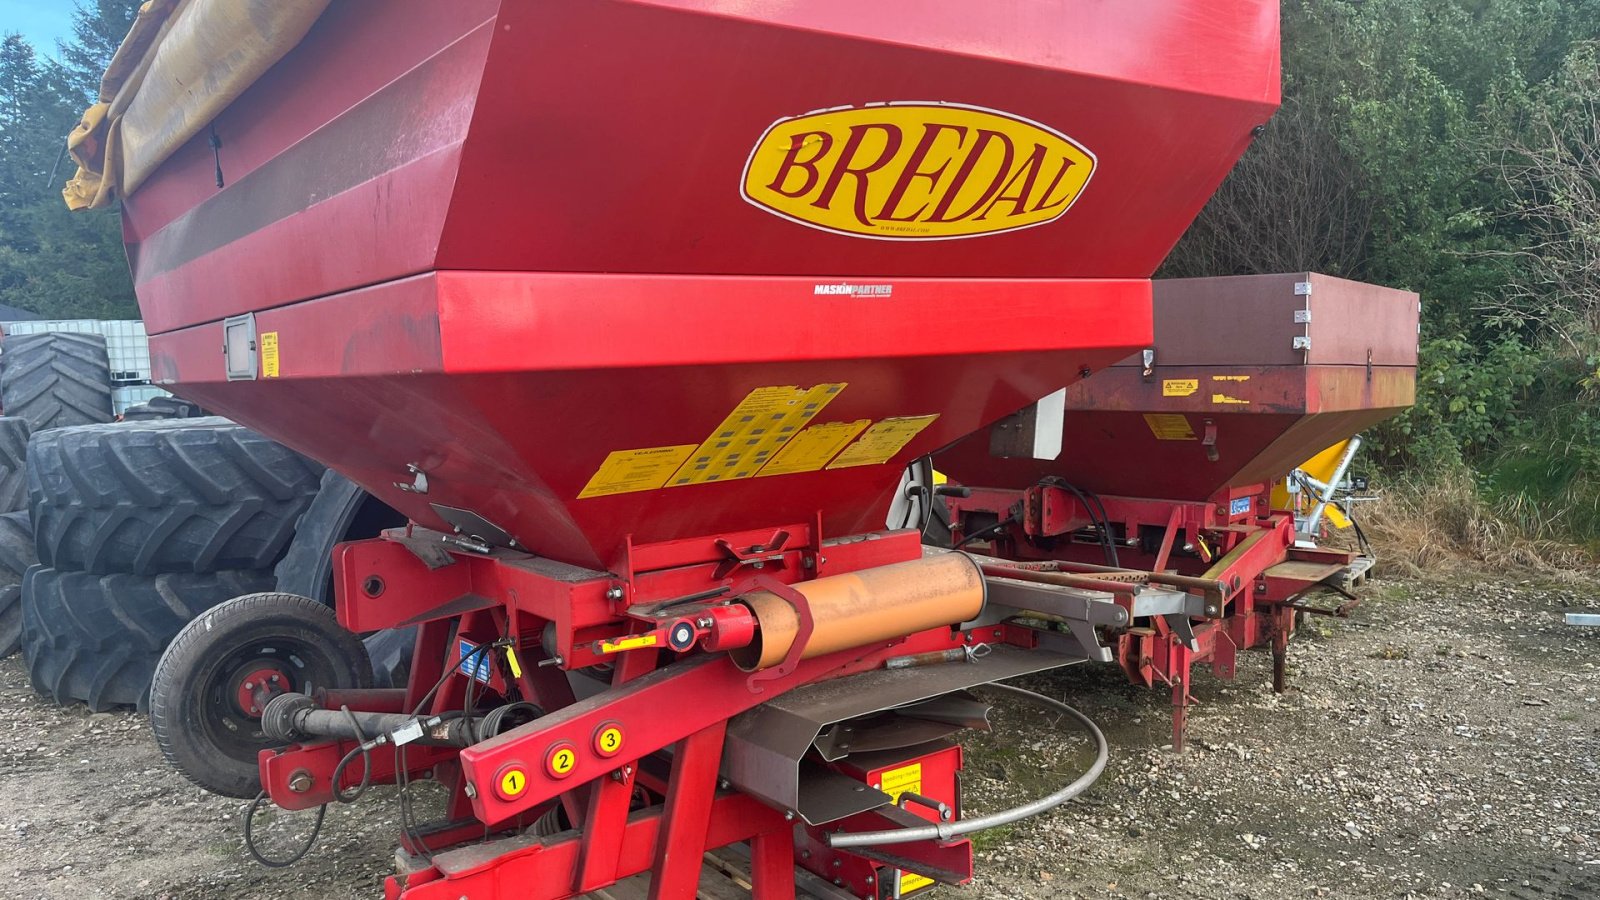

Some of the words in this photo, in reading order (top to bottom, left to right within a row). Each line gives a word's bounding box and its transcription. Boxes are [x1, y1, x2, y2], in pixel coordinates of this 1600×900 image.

[766, 122, 1077, 227] BREDAL
[606, 733, 616, 747] 3
[559, 754, 569, 769] 2
[508, 775, 517, 790] 1
